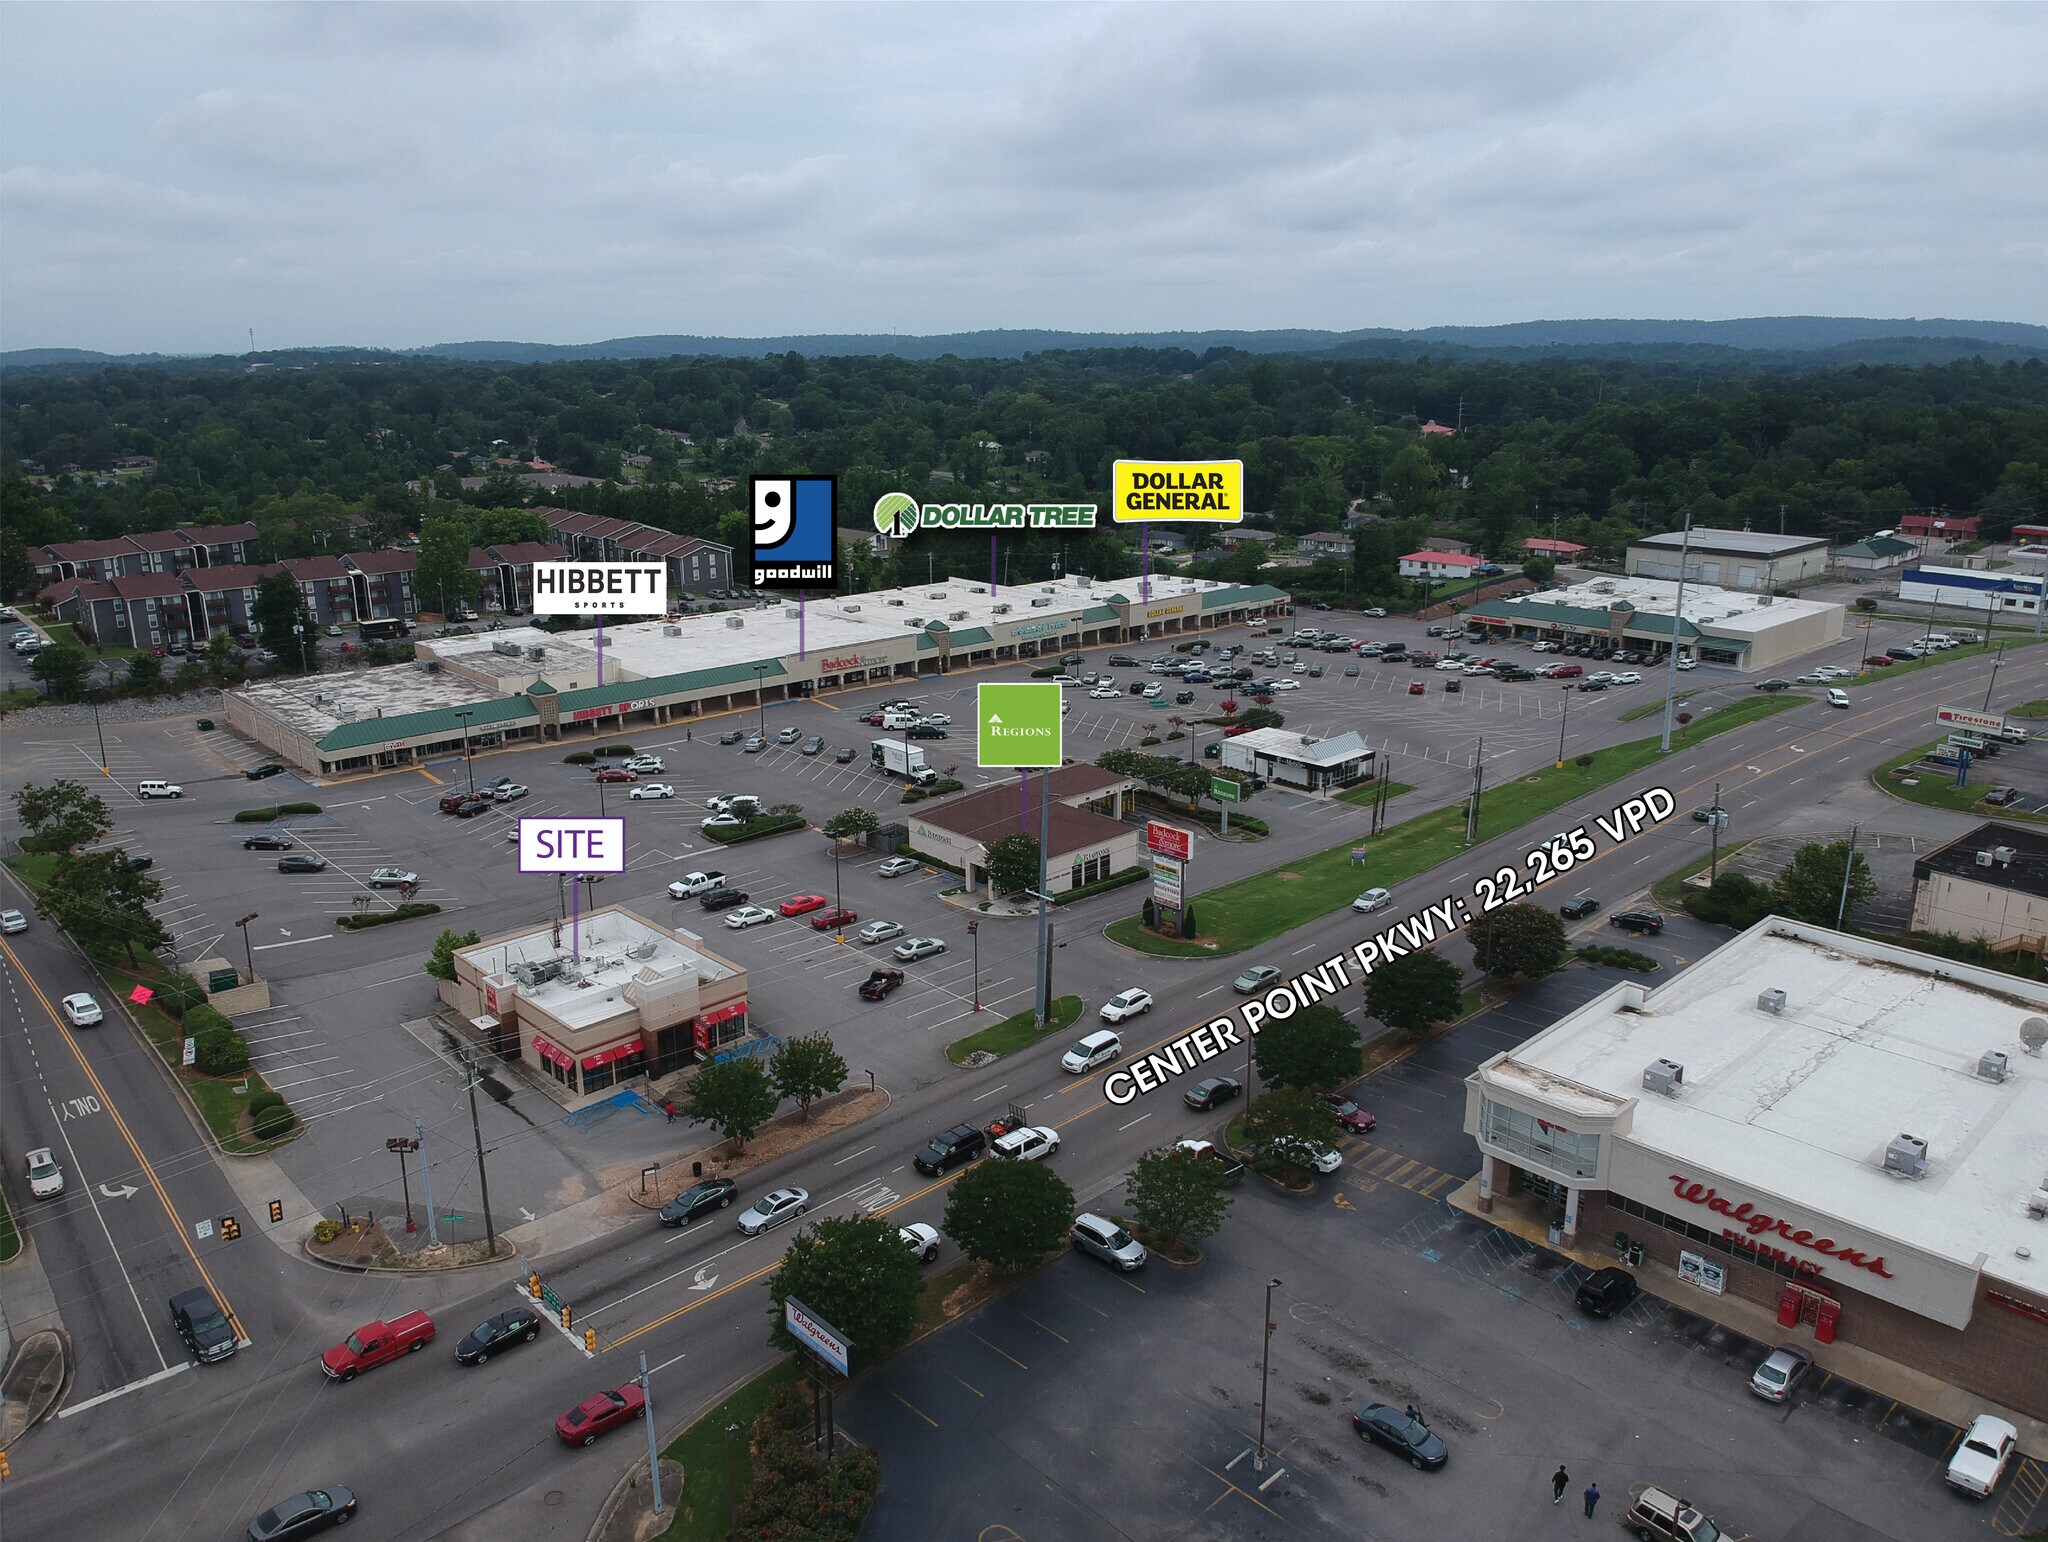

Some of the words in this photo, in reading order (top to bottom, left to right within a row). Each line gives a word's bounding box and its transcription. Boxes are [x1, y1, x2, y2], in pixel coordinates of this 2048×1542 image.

[821, 653, 860, 670] Badcock
[573, 705, 613, 721] HIBBETT
[618, 698, 656, 714] SPORTS
[1953, 713, 2001, 727] Firestone
[1152, 825, 1181, 841] Badcock
[61, 1095, 101, 1122] ONLY
[1668, 1173, 1894, 1280] Walgreens
[1721, 1227, 1825, 1280] PHARMACY
[792, 1307, 842, 1356] Walgreens
